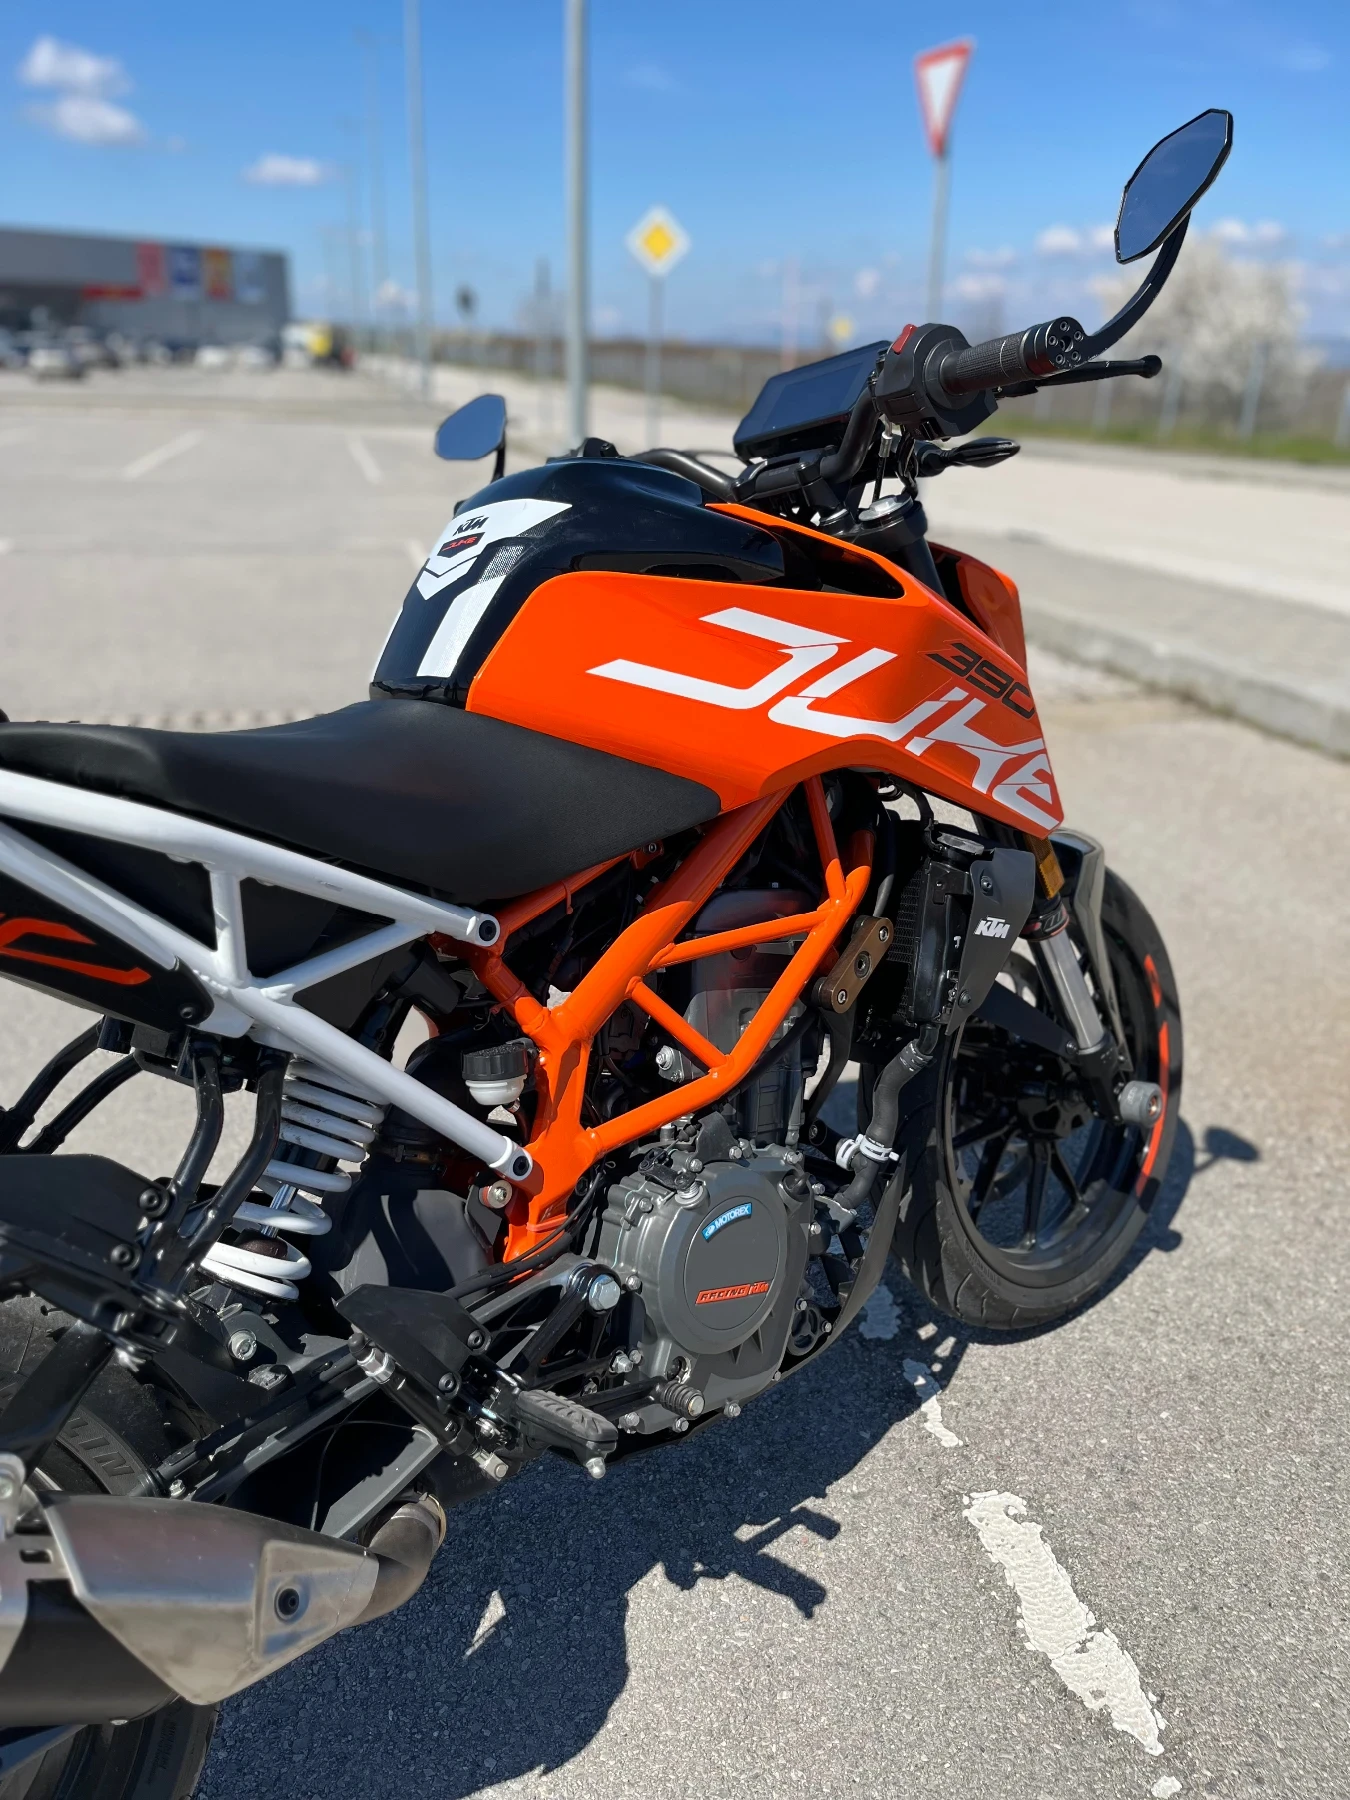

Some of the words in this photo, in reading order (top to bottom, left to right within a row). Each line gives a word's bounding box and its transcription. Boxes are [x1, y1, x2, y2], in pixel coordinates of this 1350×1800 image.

[453, 515, 489, 536] KTM
[925, 642, 1035, 720] 390
[585, 607, 1060, 831] DUKE
[974, 915, 1011, 939] KTM
[714, 1206, 749, 1228] MOTOREX
[700, 1286, 747, 1302] RACING
